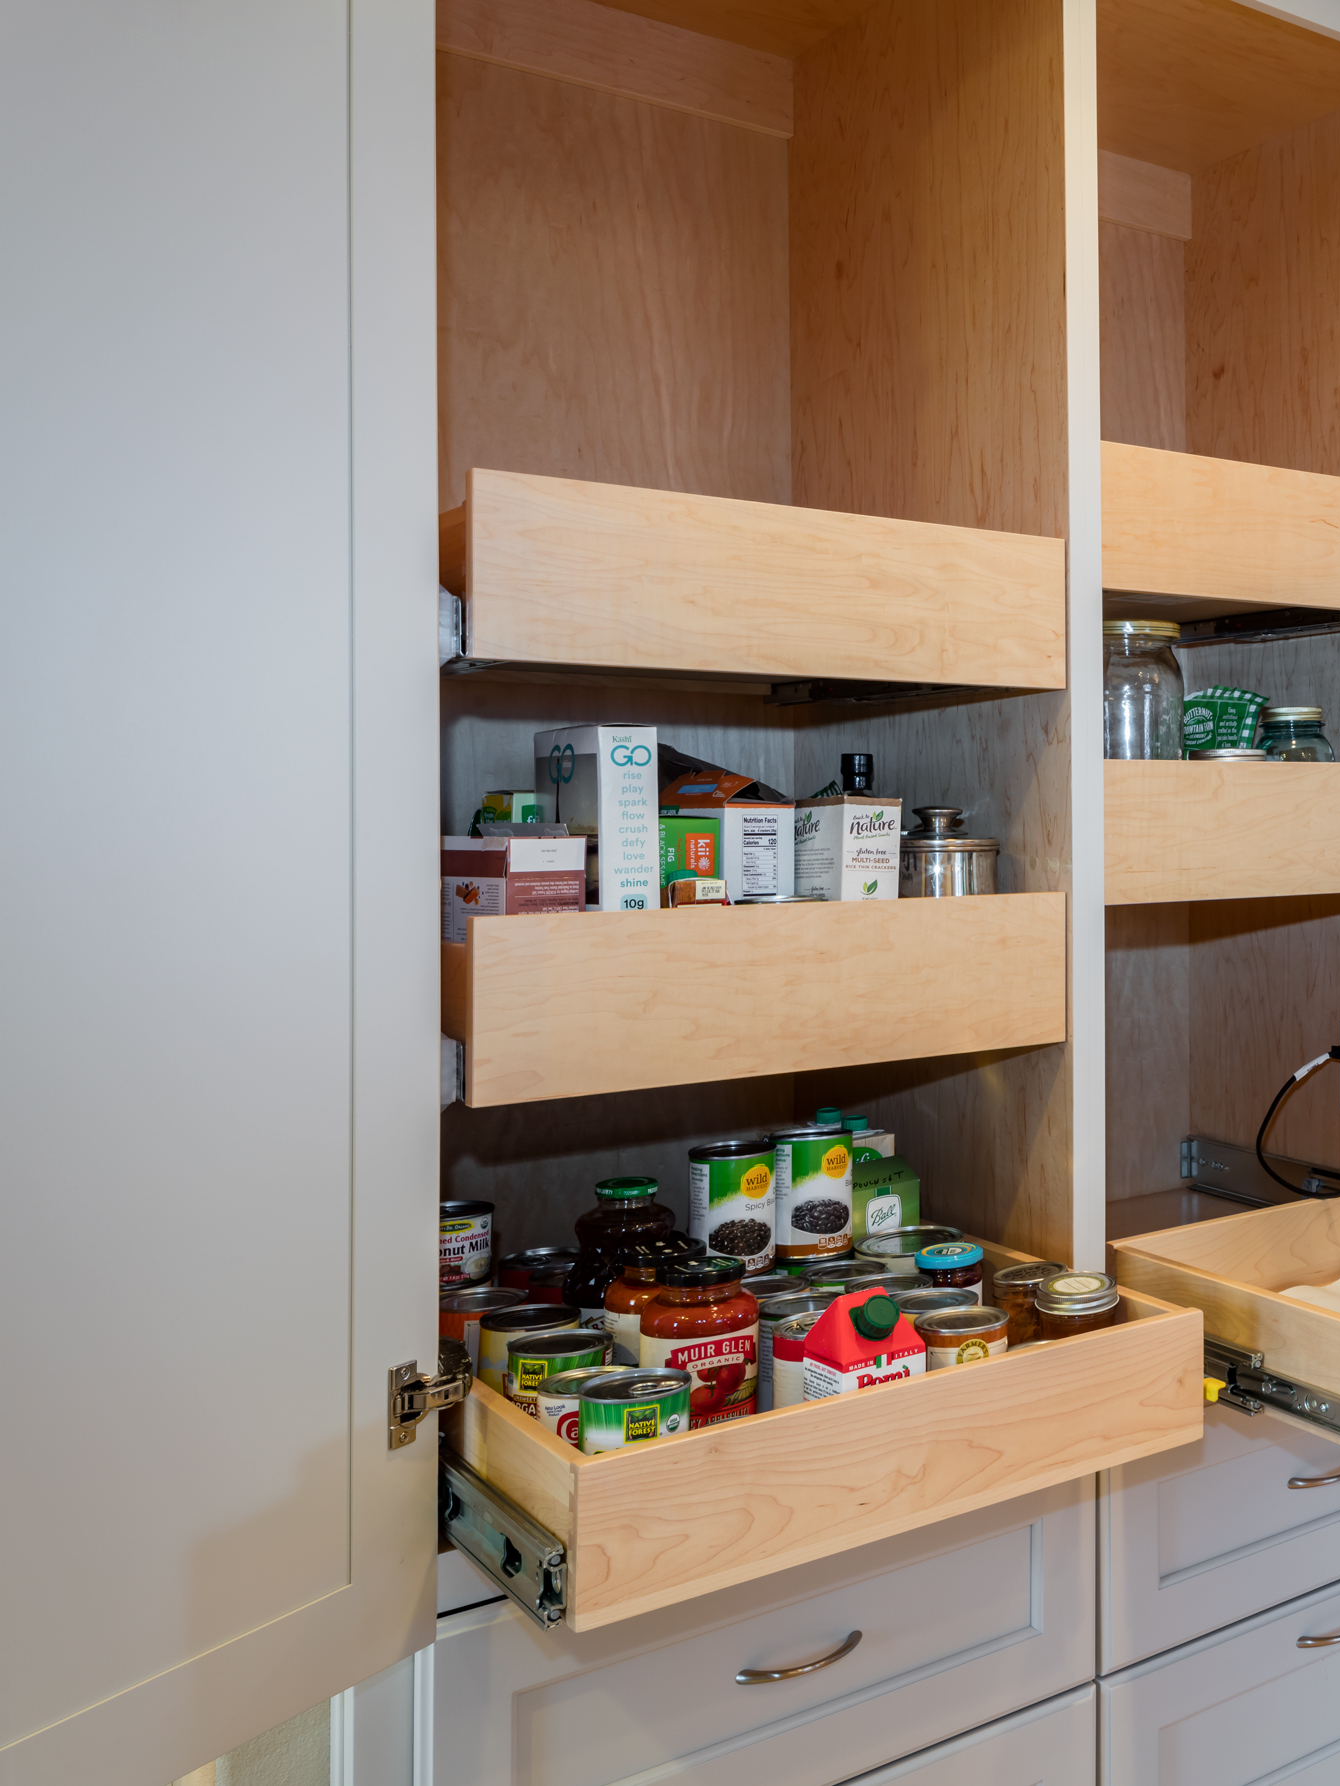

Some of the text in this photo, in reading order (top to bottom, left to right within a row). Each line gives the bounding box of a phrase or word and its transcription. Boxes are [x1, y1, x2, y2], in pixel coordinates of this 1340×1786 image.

[612, 735, 632, 743] Kashi
[610, 745, 652, 766] GO
[623, 770, 642, 780] rise
[621, 783, 644, 795] play
[618, 797, 648, 808] spark
[621, 810, 645, 820] flow
[743, 816, 777, 824] Nutrition Facts
[618, 824, 648, 834] crush
[849, 816, 896, 835] nature
[621, 837, 646, 849] defy
[697, 839, 710, 856] kii
[623, 851, 645, 861] love
[856, 847, 887, 857] gluten free
[613, 864, 654, 875] wander
[620, 878, 648, 888] shine
[623, 899, 644, 910] 10g
[826, 1153, 846, 1166] wild
[826, 1164, 847, 1172] HARVEST
[745, 1172, 768, 1186] wild
[746, 1183, 769, 1192] HARVEST
[745, 1202, 765, 1212] Spicy
[871, 1203, 897, 1226] Ball
[454, 1228, 490, 1243] Condensed
[468, 1237, 490, 1253] Milk
[677, 1339, 751, 1365] MUIR GLEN
[958, 1340, 989, 1358] FARMERS
[692, 1355, 741, 1370] ORGANIC
[848, 1363, 865, 1371] MADE
[895, 1348, 919, 1359] ITALY
[554, 1403, 566, 1411] Look
[628, 1419, 656, 1429] NATIVE
[628, 1426, 656, 1436] FOREST
